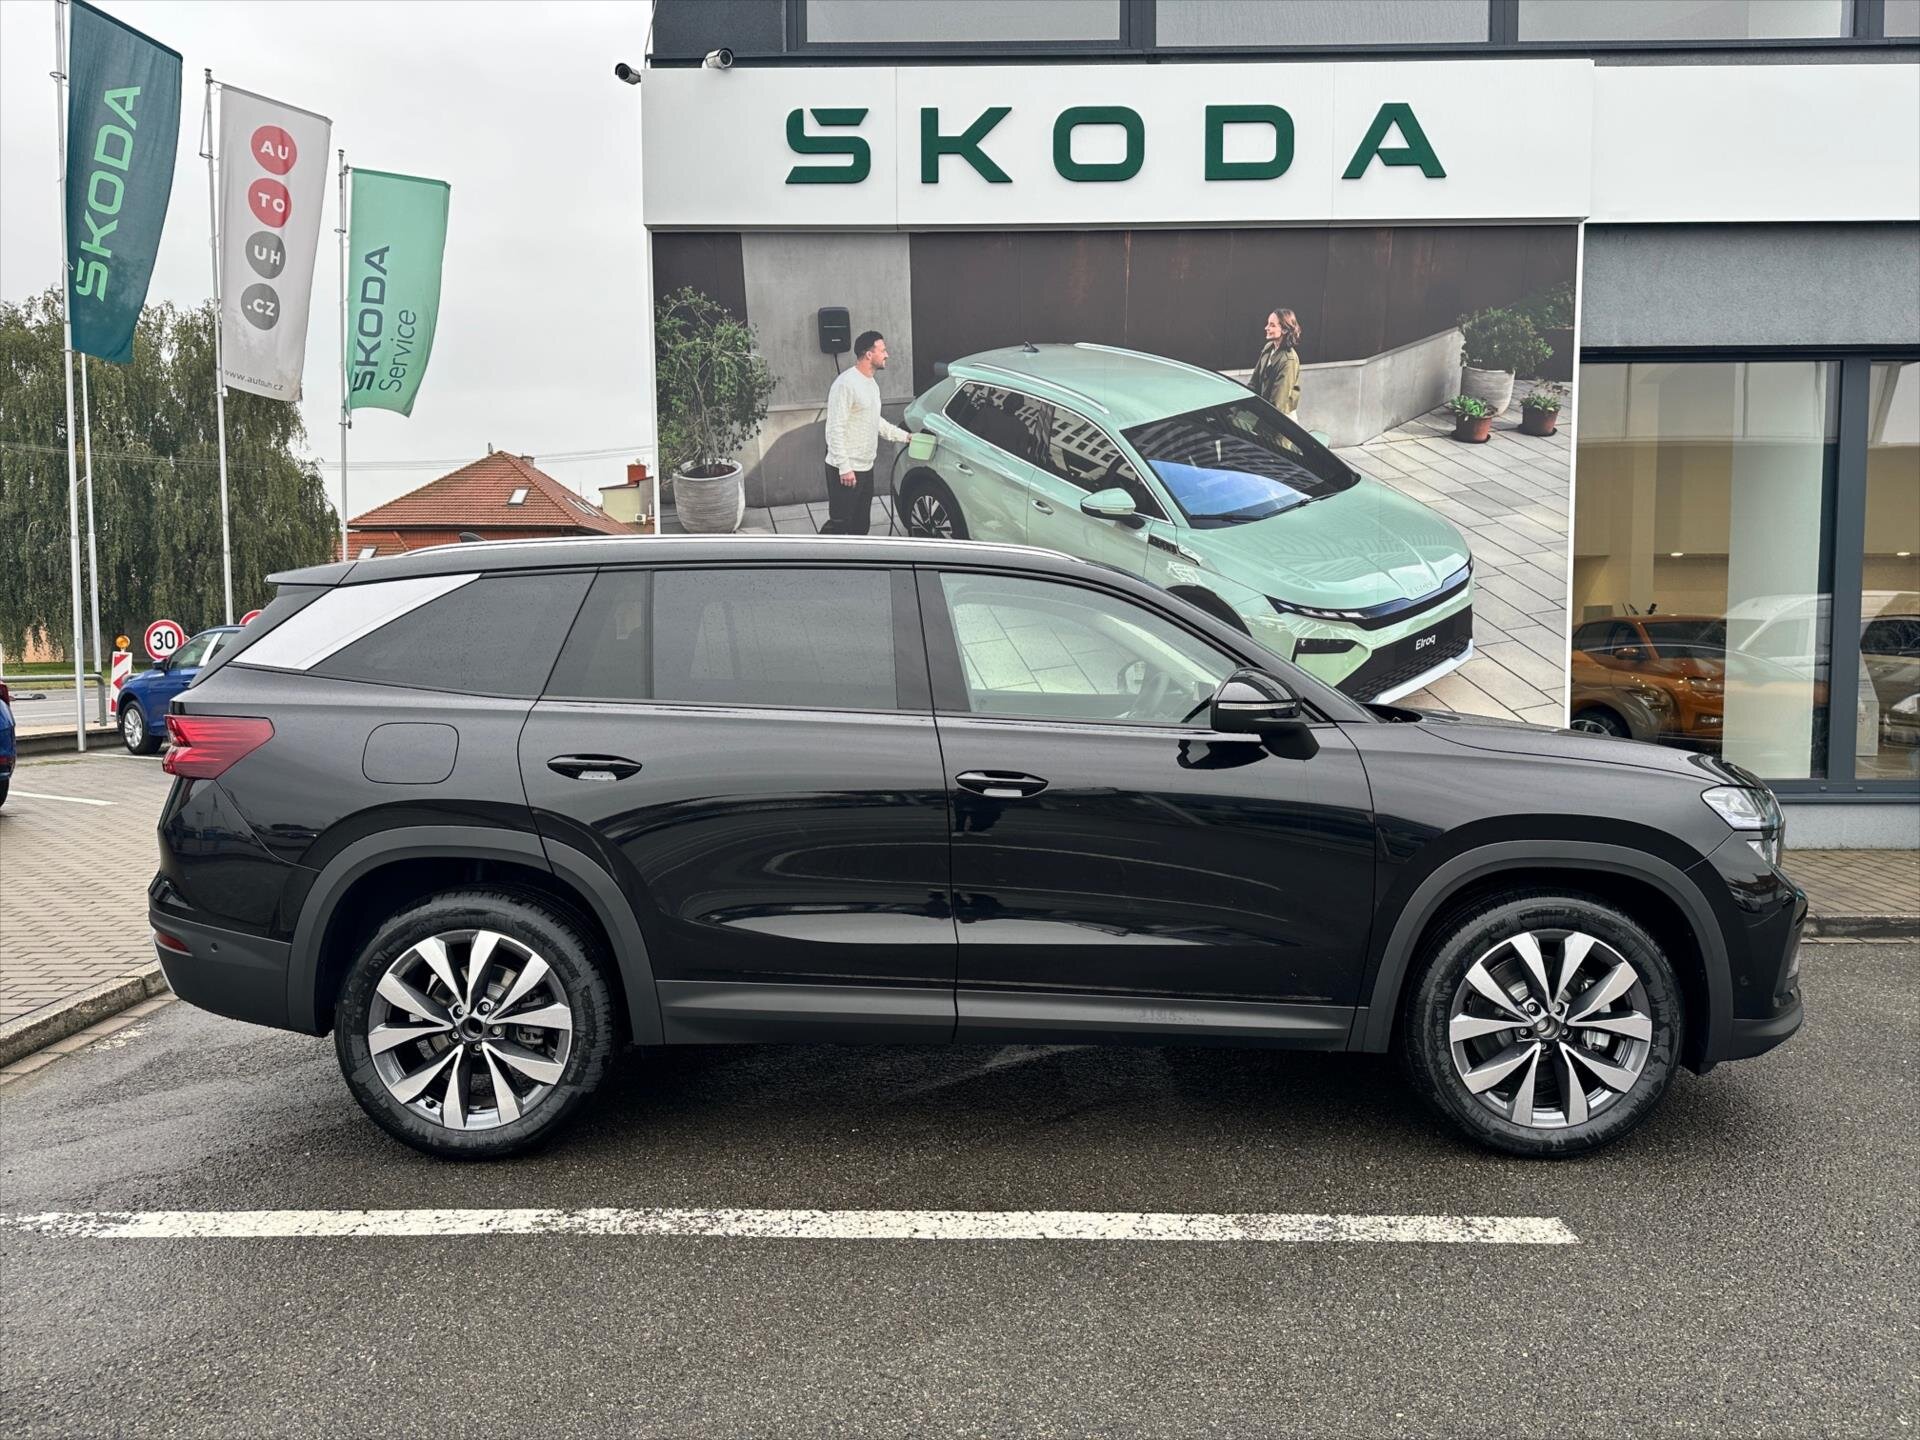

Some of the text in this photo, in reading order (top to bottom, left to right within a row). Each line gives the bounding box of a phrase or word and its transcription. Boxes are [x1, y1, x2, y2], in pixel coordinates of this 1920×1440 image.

[260, 140, 289, 160] AU
[257, 192, 286, 213] TO
[253, 244, 282, 266] UH
[246, 297, 275, 317] .CZ
[378, 309, 416, 392] Service
[153, 631, 175, 650] 30
[1415, 634, 1436, 651] Elroq
